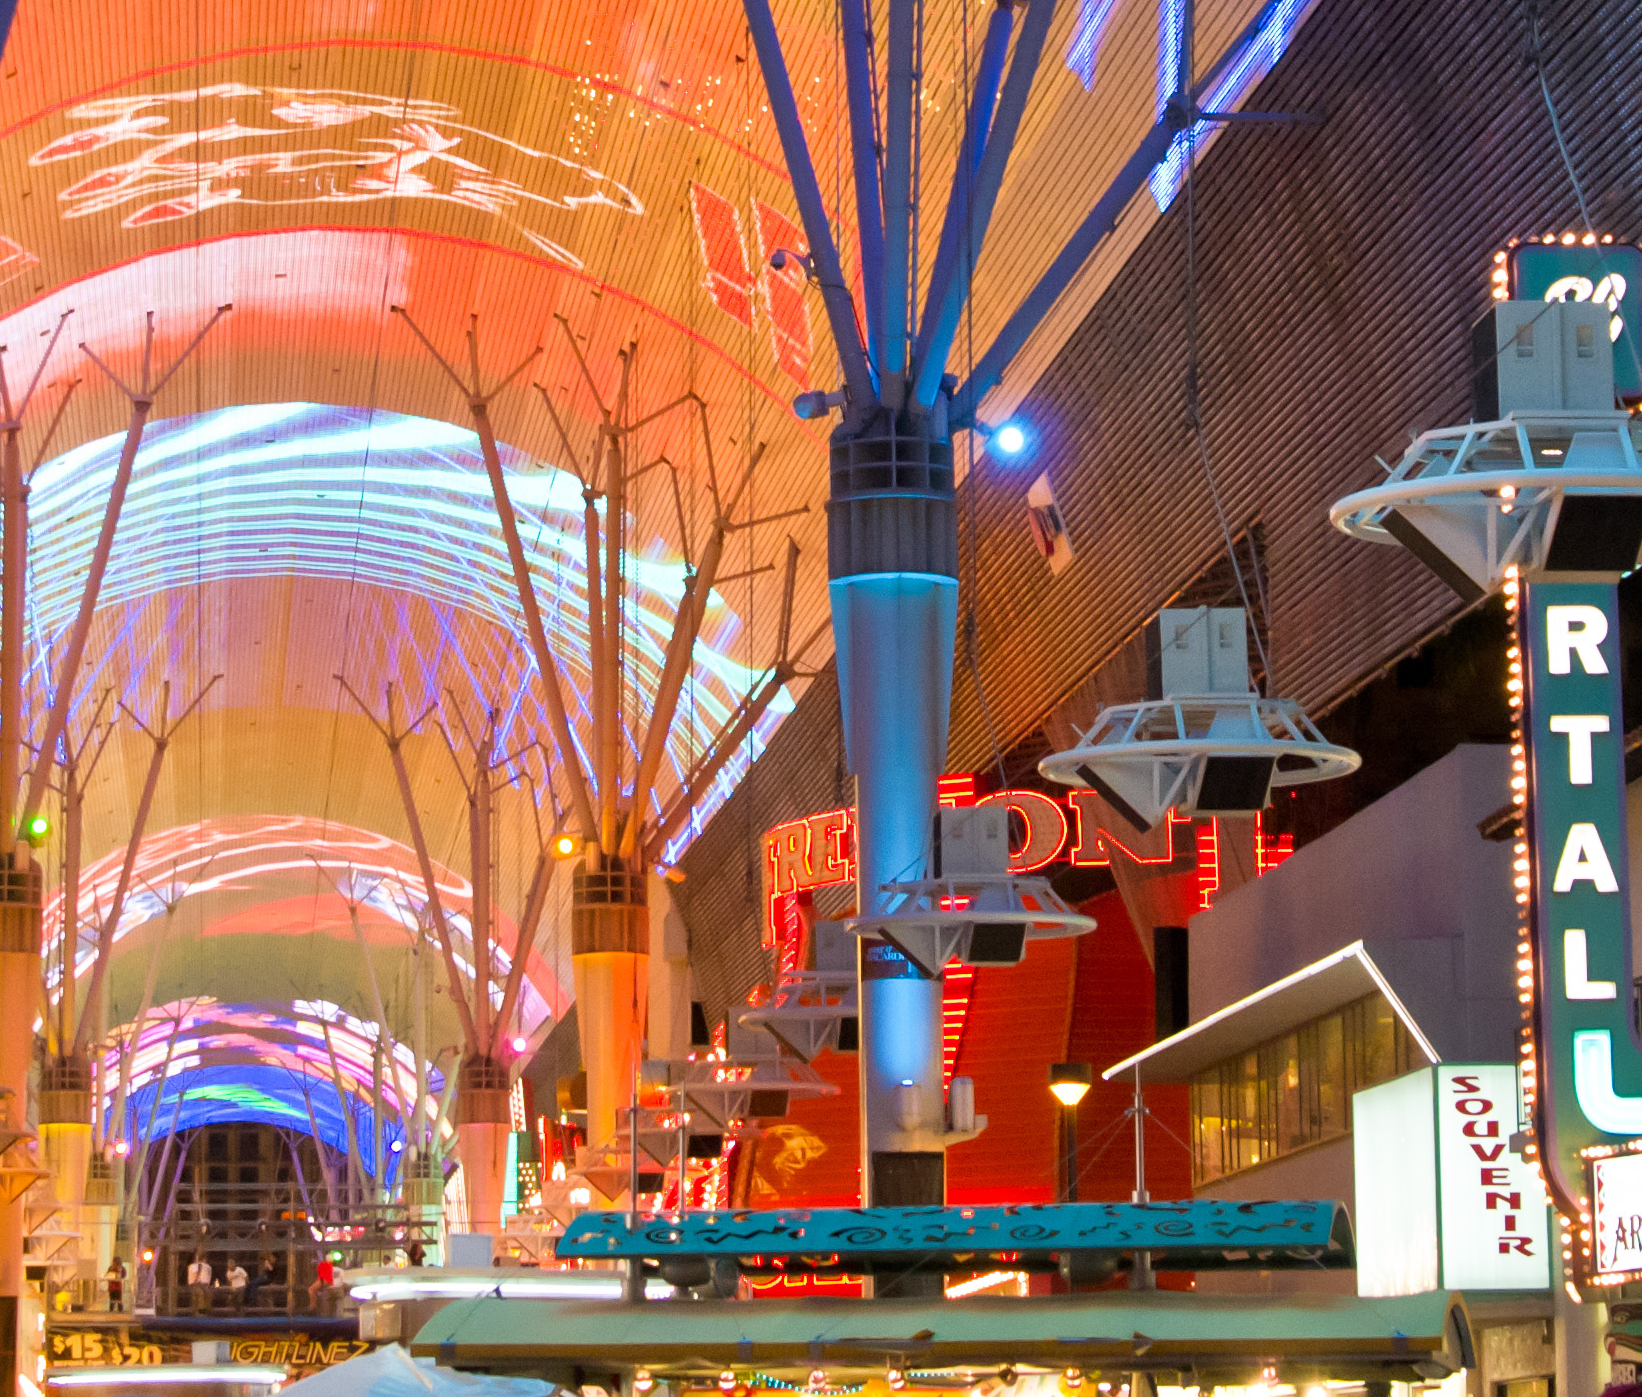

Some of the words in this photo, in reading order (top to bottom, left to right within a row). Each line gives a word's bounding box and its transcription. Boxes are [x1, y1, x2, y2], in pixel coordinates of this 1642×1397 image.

[1451, 1075, 1536, 1258] SOUVENIR
[53, 1333, 104, 1360] $15
[229, 1341, 370, 1365] IGHTLINEZ
